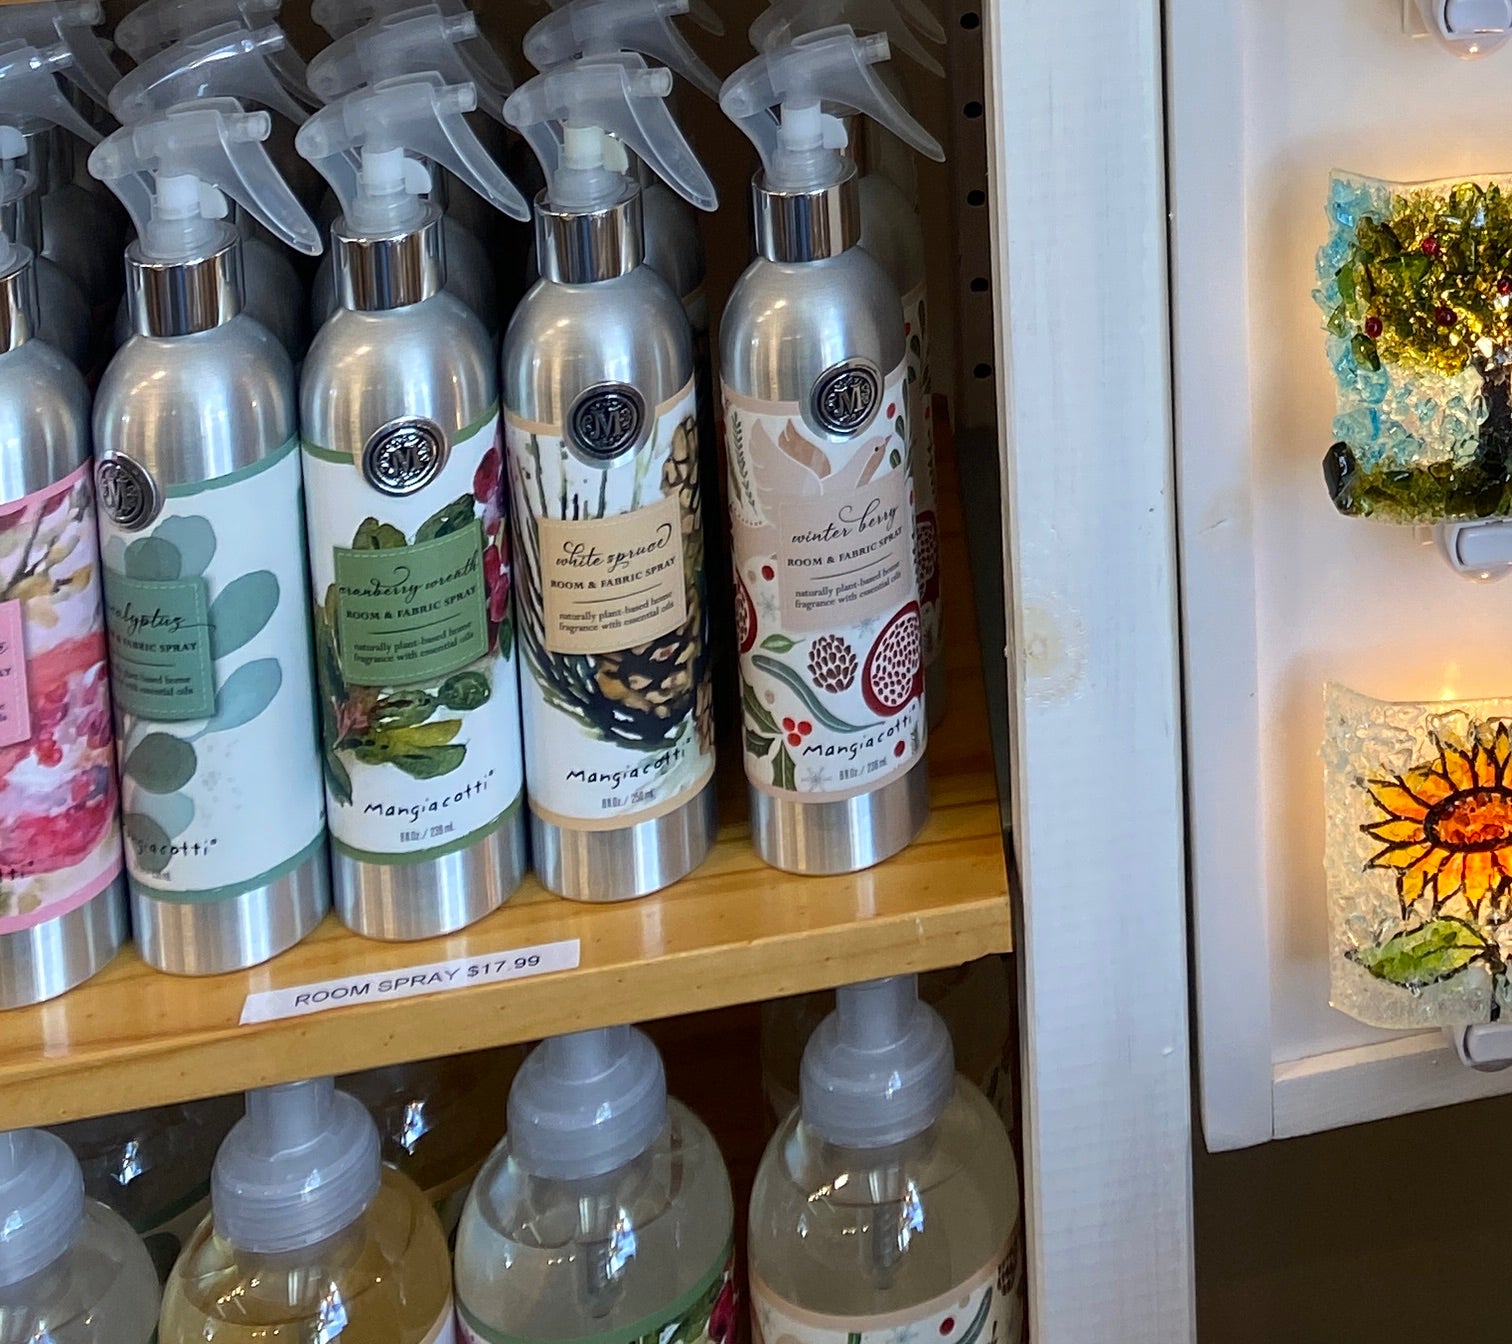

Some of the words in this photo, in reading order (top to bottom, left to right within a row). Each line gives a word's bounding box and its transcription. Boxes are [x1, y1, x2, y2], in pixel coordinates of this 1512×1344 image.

[792, 522, 853, 544] winter
[838, 498, 899, 532] berry
[556, 540, 604, 568] white
[607, 522, 672, 573] spruce
[787, 558, 822, 567] ROOM
[826, 556, 835, 564] &
[839, 542, 877, 562] FABRIC
[878, 526, 903, 549] SPRAY
[339, 566, 421, 605] cranberry
[425, 550, 479, 590] wreath
[550, 579, 584, 590] ROOM
[588, 581, 596, 589] &
[600, 571, 643, 589] FABRIC
[645, 556, 677, 578] SPRAY
[346, 610, 380, 621] ROOM
[397, 600, 442, 618] FABRIC
[444, 585, 477, 606] SPRAY
[160, 642, 197, 653] SPRAY
[295, 982, 371, 1007] ROOM
[377, 968, 461, 994] SPRAY
[467, 955, 541, 978] $17.99
